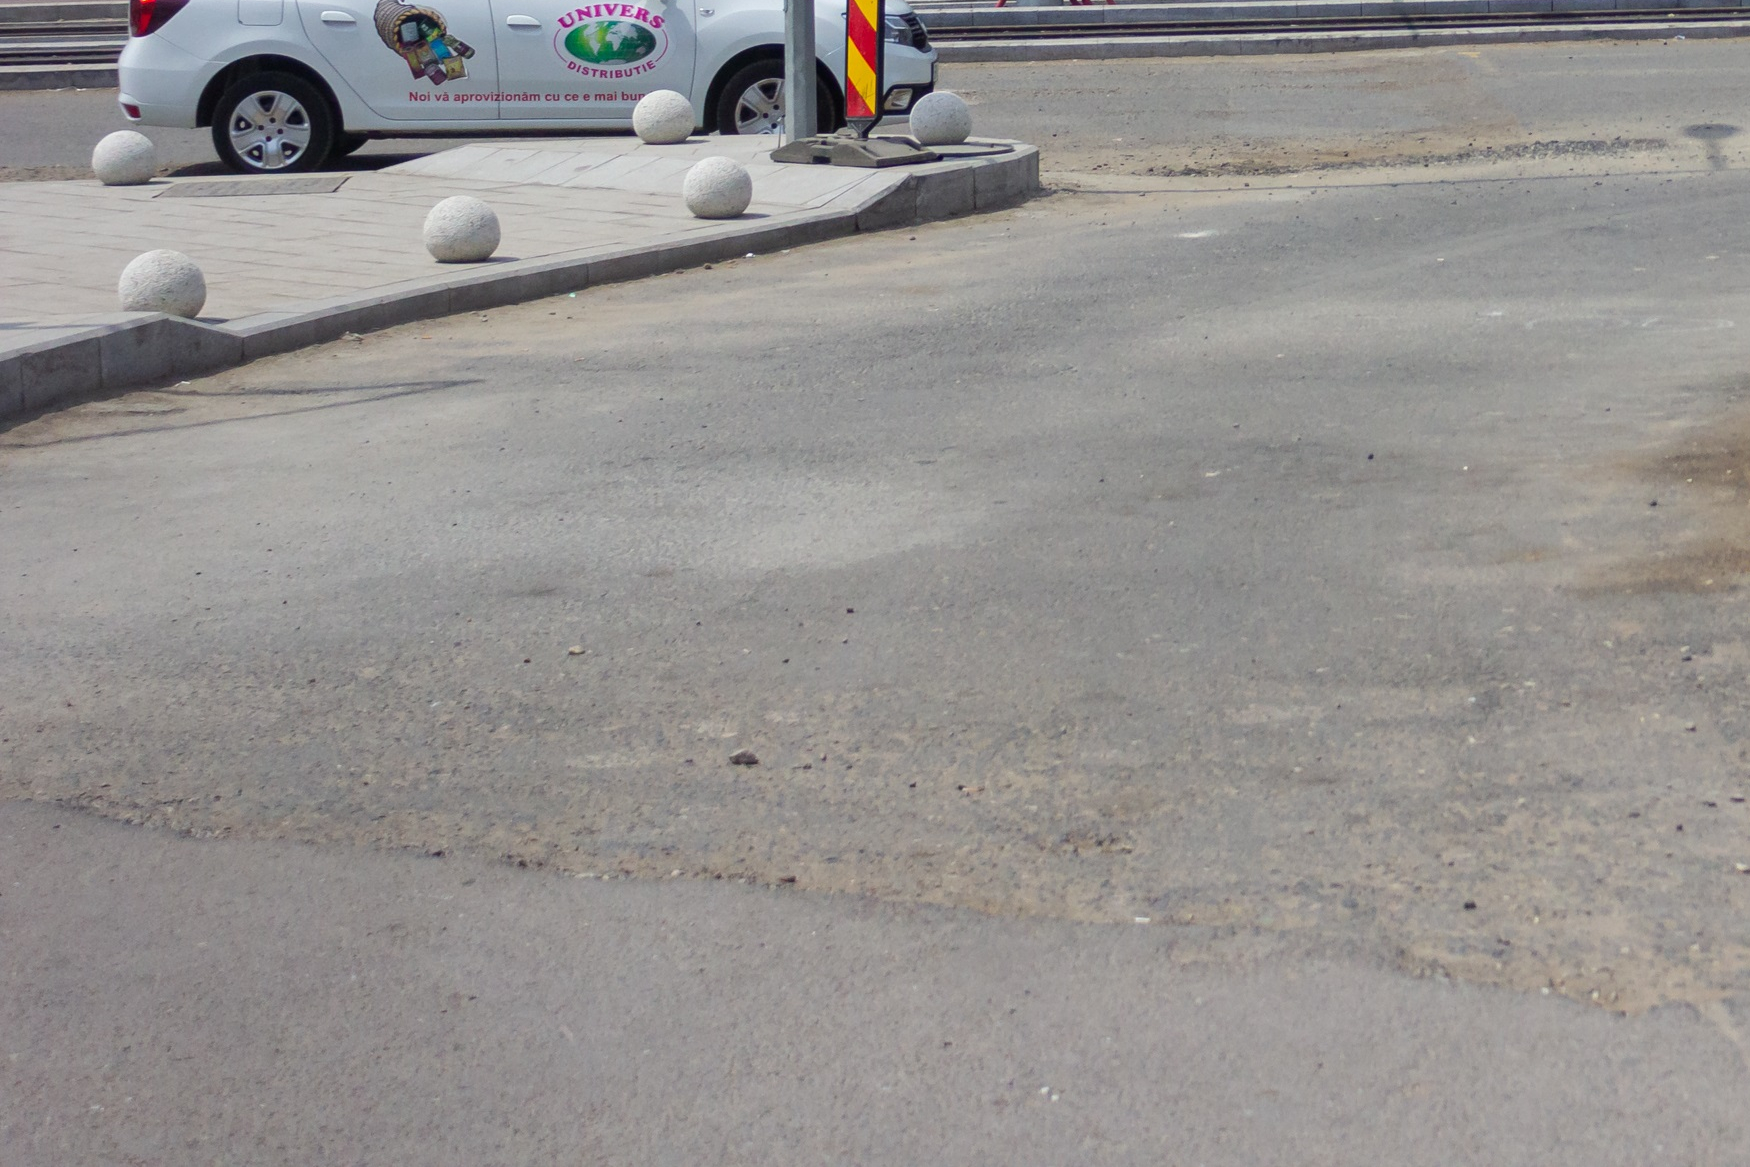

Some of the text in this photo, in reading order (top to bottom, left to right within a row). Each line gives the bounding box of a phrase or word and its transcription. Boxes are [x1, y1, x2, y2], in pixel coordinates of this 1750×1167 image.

[557, 3, 666, 30] UNIVERS
[566, 59, 657, 79] DISTRIBUTIE
[409, 91, 431, 102] Noi
[434, 91, 450, 102] vă
[453, 91, 540, 105] aprovizionăm
[544, 93, 560, 102] cu
[564, 93, 579, 102] ce
[583, 93, 591, 102] e
[598, 91, 618, 102] mai
